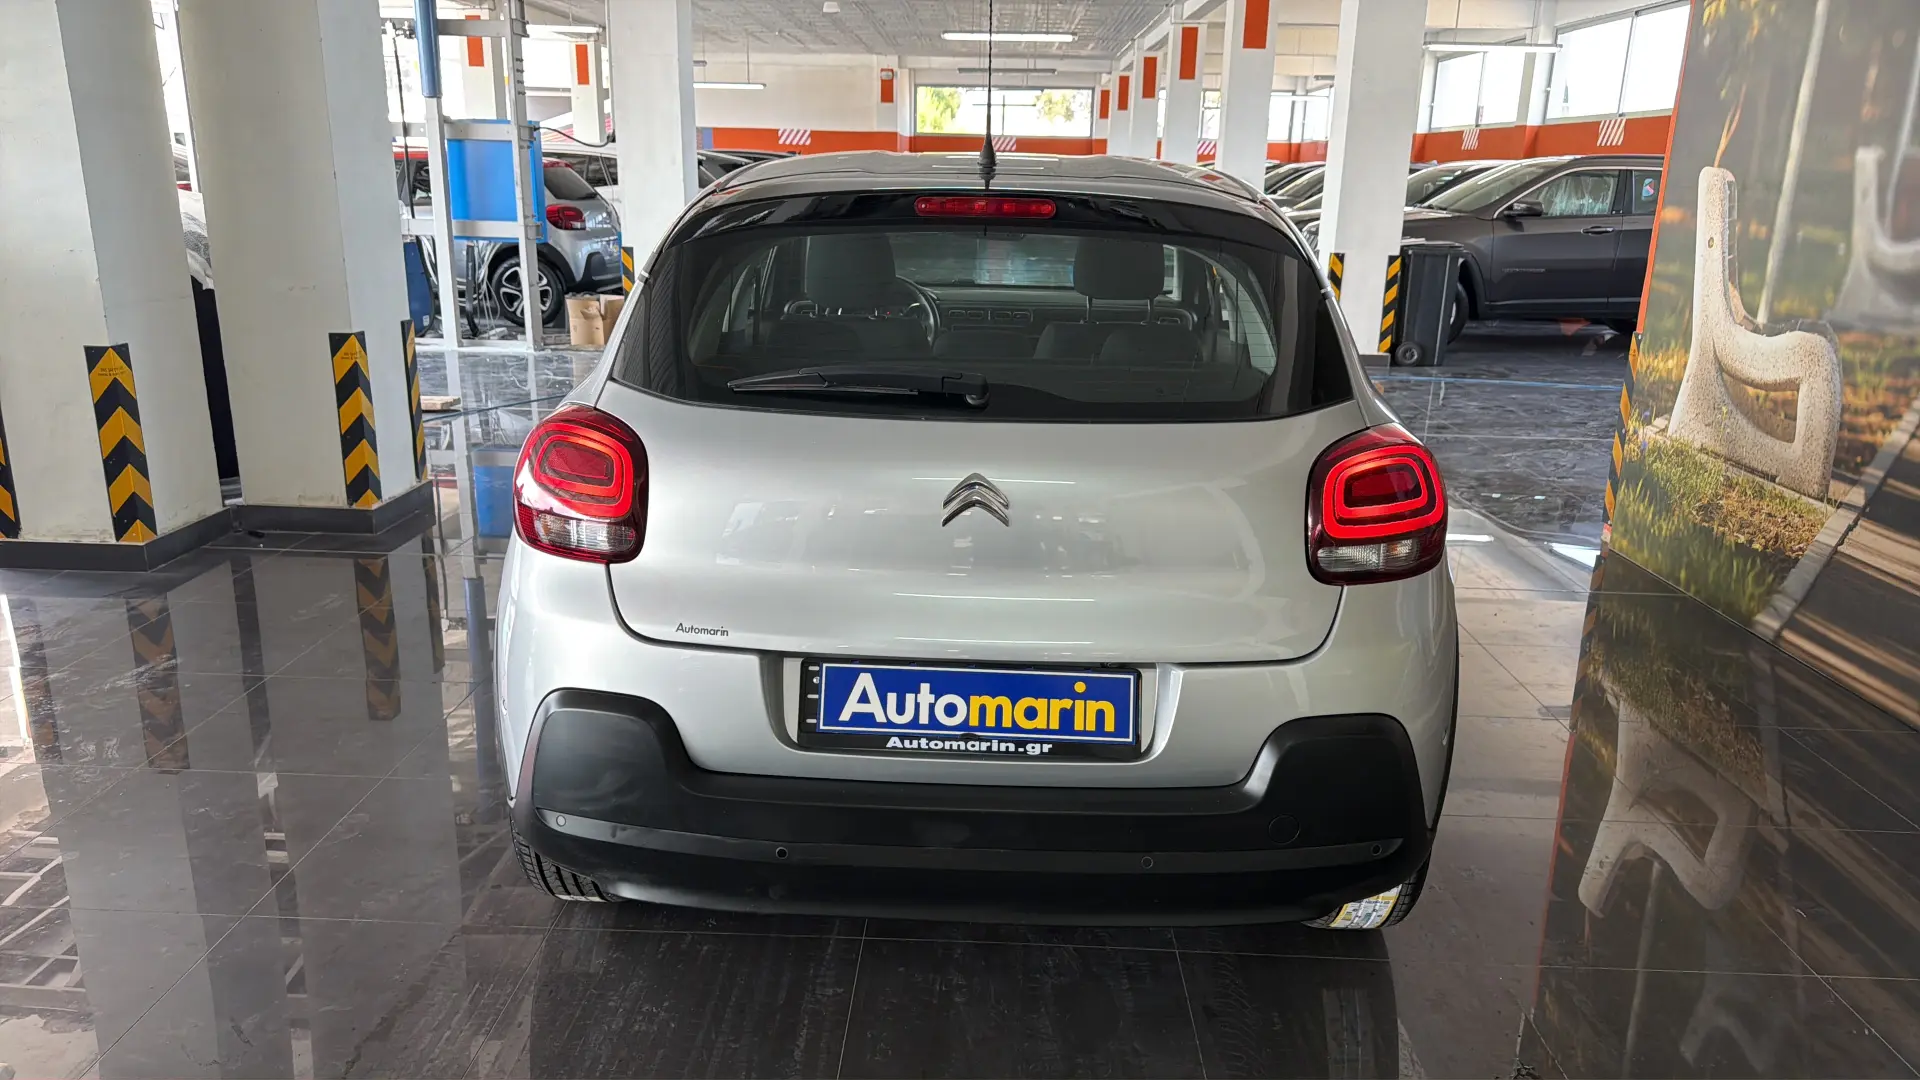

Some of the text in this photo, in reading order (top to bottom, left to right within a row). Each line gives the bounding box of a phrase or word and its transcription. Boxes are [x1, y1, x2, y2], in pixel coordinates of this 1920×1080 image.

[675, 622, 729, 637] Automarin
[838, 672, 1115, 732] Automarin
[885, 736, 1053, 755] Automarin.gr
